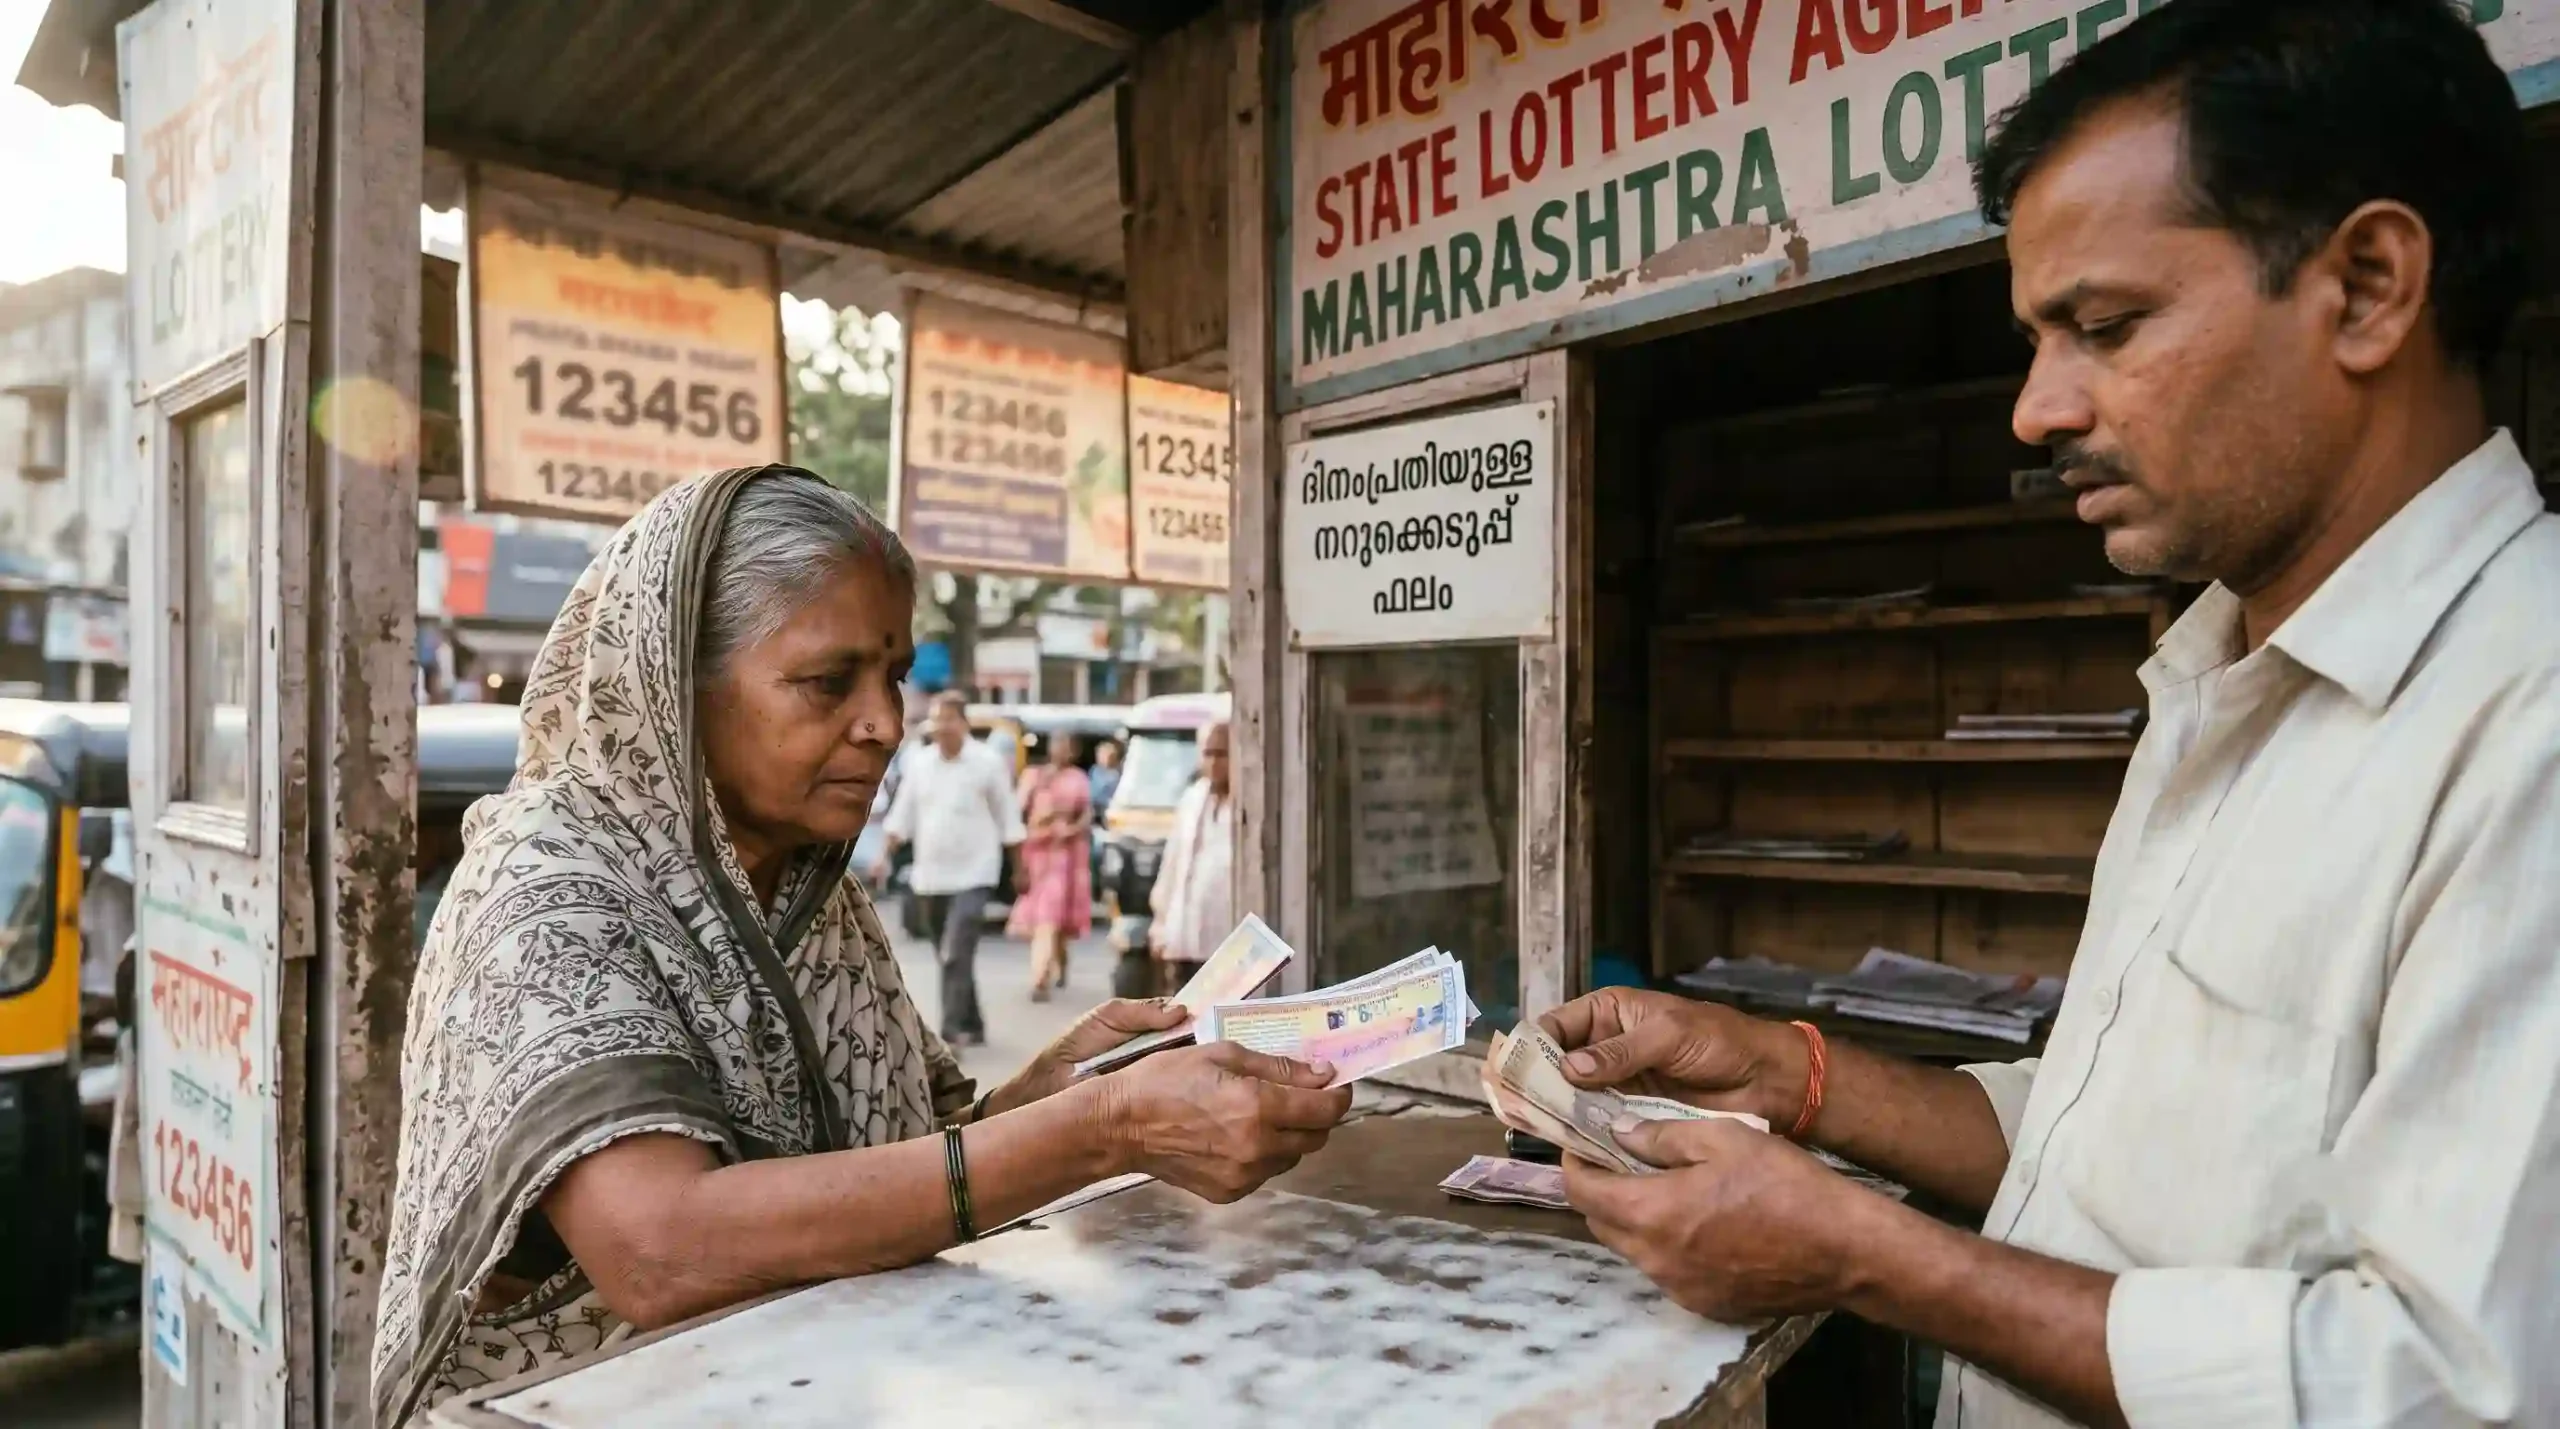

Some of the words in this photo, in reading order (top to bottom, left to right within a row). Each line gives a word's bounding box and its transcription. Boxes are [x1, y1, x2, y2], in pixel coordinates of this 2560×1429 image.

[1316, 126, 1458, 259] STATE
[1479, 0, 1762, 199] LOTTERY
[151, 184, 275, 345] LOTTERY
[1302, 127, 1788, 366] MAHARASHTRA
[514, 355, 762, 445] 123456
[1373, 575, 1453, 614] ഫലം
[155, 1119, 253, 1271] 123456
